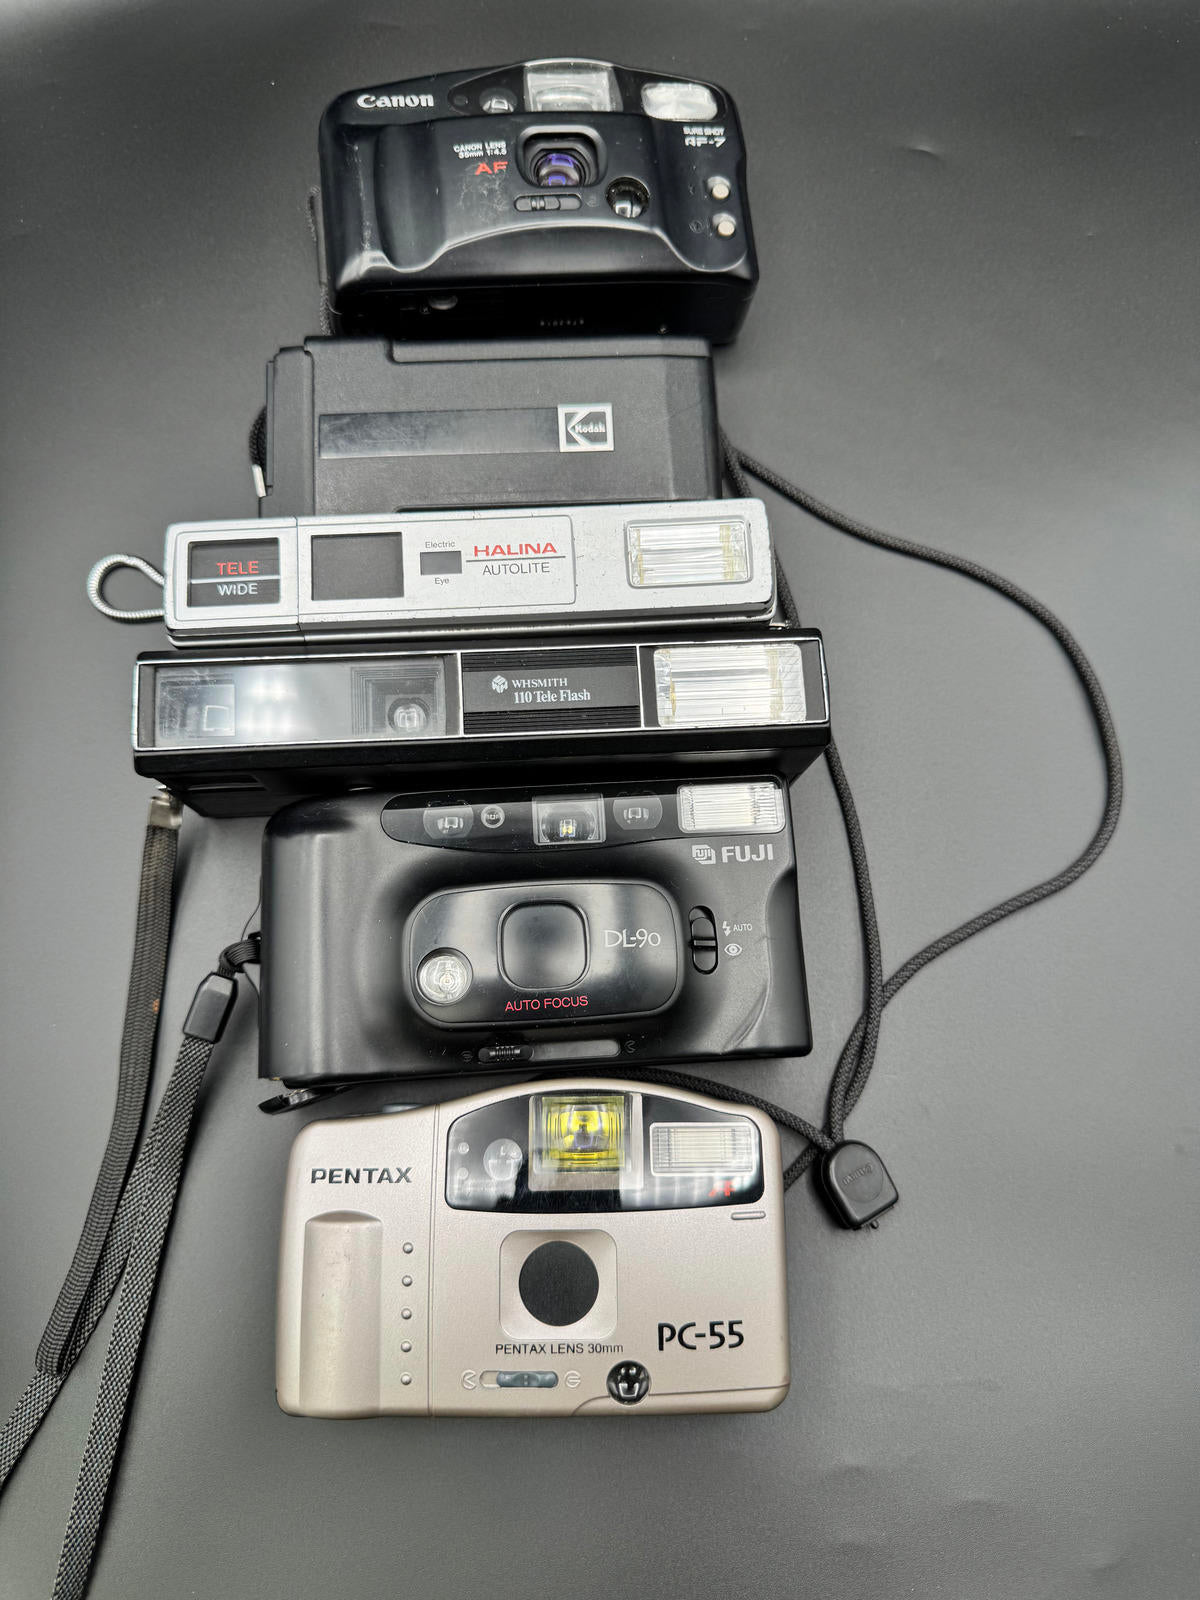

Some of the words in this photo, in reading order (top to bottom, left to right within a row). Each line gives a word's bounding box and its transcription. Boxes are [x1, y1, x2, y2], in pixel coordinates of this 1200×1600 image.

[357, 94, 434, 108] Canon
[453, 143, 482, 153] CANON
[484, 140, 506, 150] LENS
[475, 161, 508, 176] AF
[574, 421, 606, 433] Kodak
[425, 540, 456, 549] Electric
[474, 542, 557, 557] HALINA
[216, 560, 259, 575] TELE
[482, 562, 550, 576] AUTOLITE
[434, 577, 450, 587] Eye
[217, 583, 259, 596] WIDE
[511, 677, 568, 689] WHSMITH
[514, 691, 532, 704] 110
[533, 690, 558, 703] Tele
[559, 688, 591, 702] Flash
[721, 843, 774, 863] FUJI
[733, 923, 753, 932] AUTO
[604, 928, 661, 948] DL-90
[505, 999, 541, 1012] AUTO
[544, 995, 589, 1009] FOCUS
[310, 1166, 412, 1184] PENTAX
[657, 1320, 744, 1351] PC-55
[495, 1343, 547, 1355] PENTAX
[550, 1342, 584, 1354] LENS
[587, 1343, 624, 1354] 30mm
